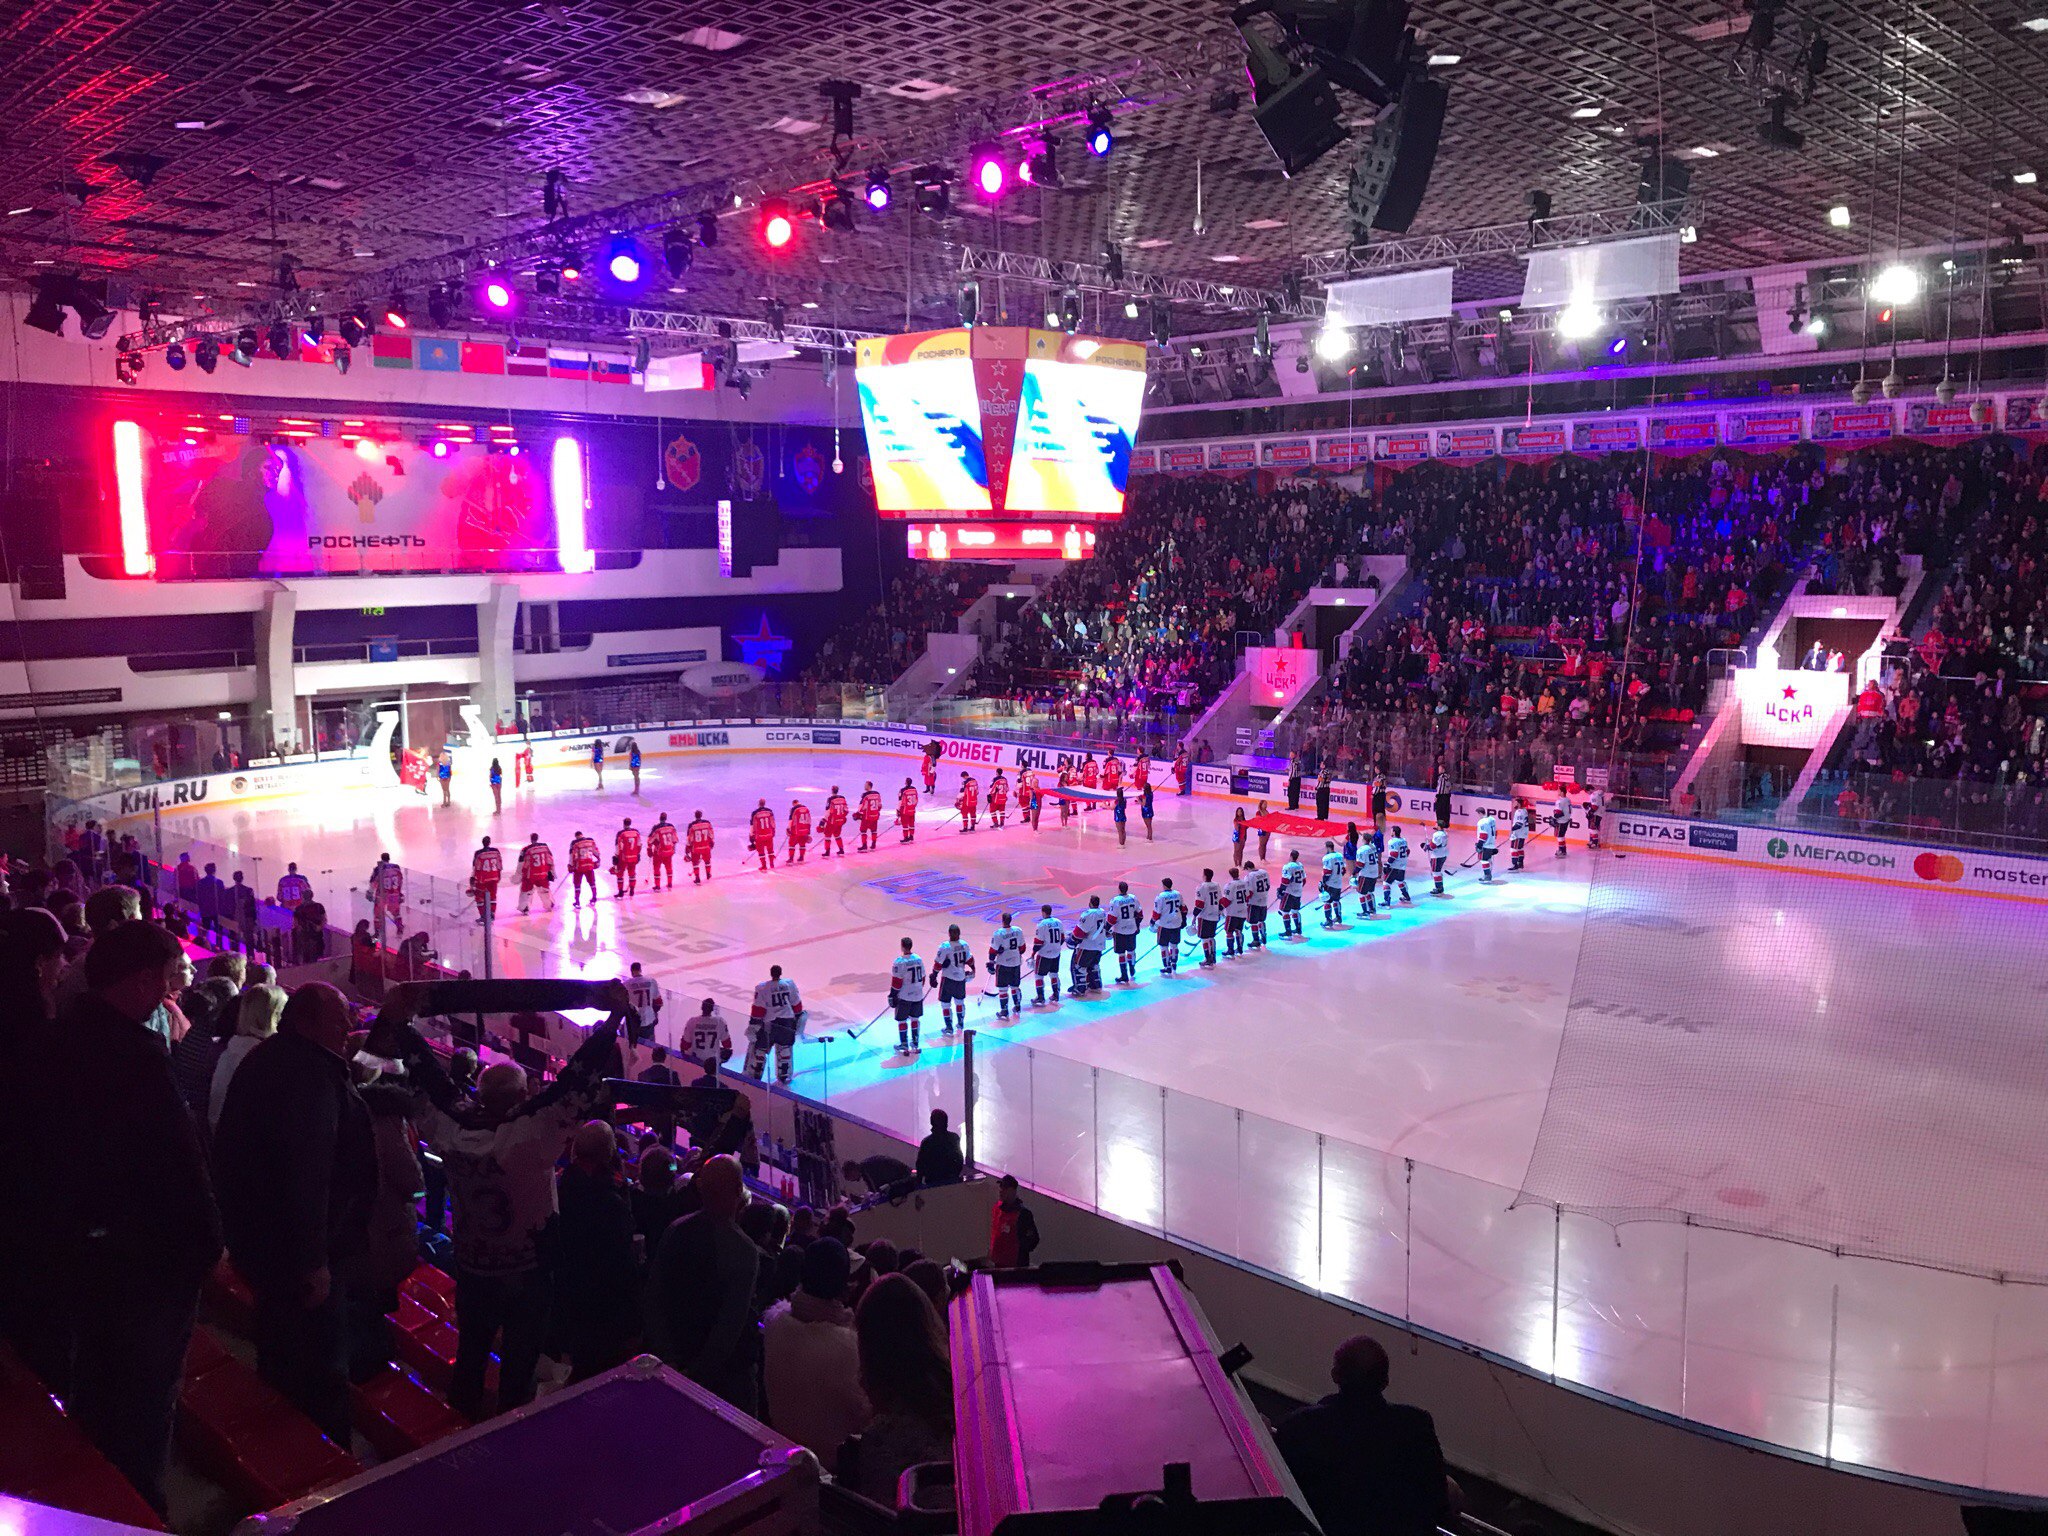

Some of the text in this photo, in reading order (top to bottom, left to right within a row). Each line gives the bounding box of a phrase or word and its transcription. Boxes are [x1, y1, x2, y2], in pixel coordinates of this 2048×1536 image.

[917, 349, 966, 359] РОСНЕФТЬ
[981, 399, 1017, 416] ЦСКА
[308, 535, 426, 549] РОСНЕФТЬ
[1266, 672, 1297, 690] ЦСКА
[1765, 702, 1813, 723] ЦСКА
[766, 732, 810, 741] СОГАЗ
[861, 736, 924, 750] РОСНЕФТЬ
[1196, 772, 1230, 786] СОГА
[121, 779, 207, 814] KHL.RU
[1619, 822, 1685, 840] СОГАЗ
[1048, 928, 1060, 944] 10
[953, 951, 966, 968] 14
[907, 966, 922, 983] 70
[633, 989, 651, 1008] 71
[695, 1031, 717, 1050] 27
